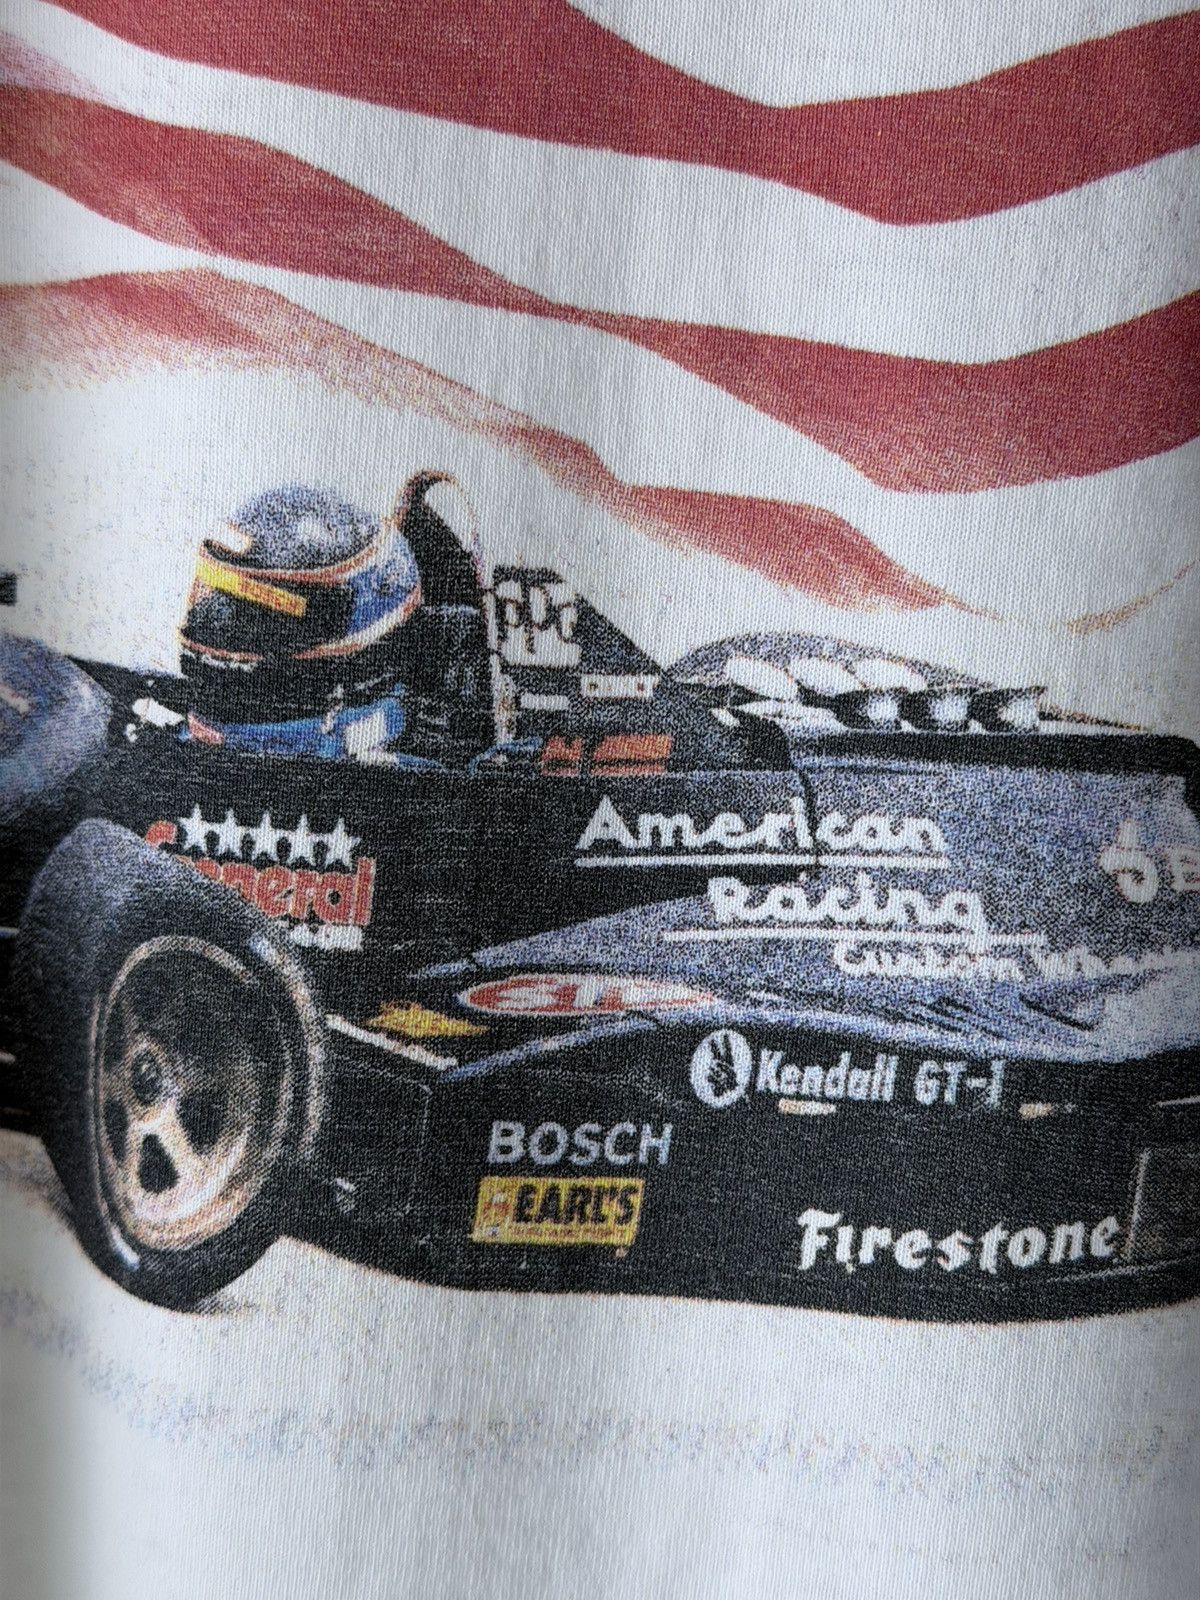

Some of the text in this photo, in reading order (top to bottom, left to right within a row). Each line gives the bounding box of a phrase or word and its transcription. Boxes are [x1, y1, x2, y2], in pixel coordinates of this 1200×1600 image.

[574, 794, 950, 852] American
[706, 873, 992, 948] Racing
[757, 1048, 899, 1102] Kendall
[486, 1120, 674, 1166] BOSCH
[797, 1207, 1121, 1276] Firestone
